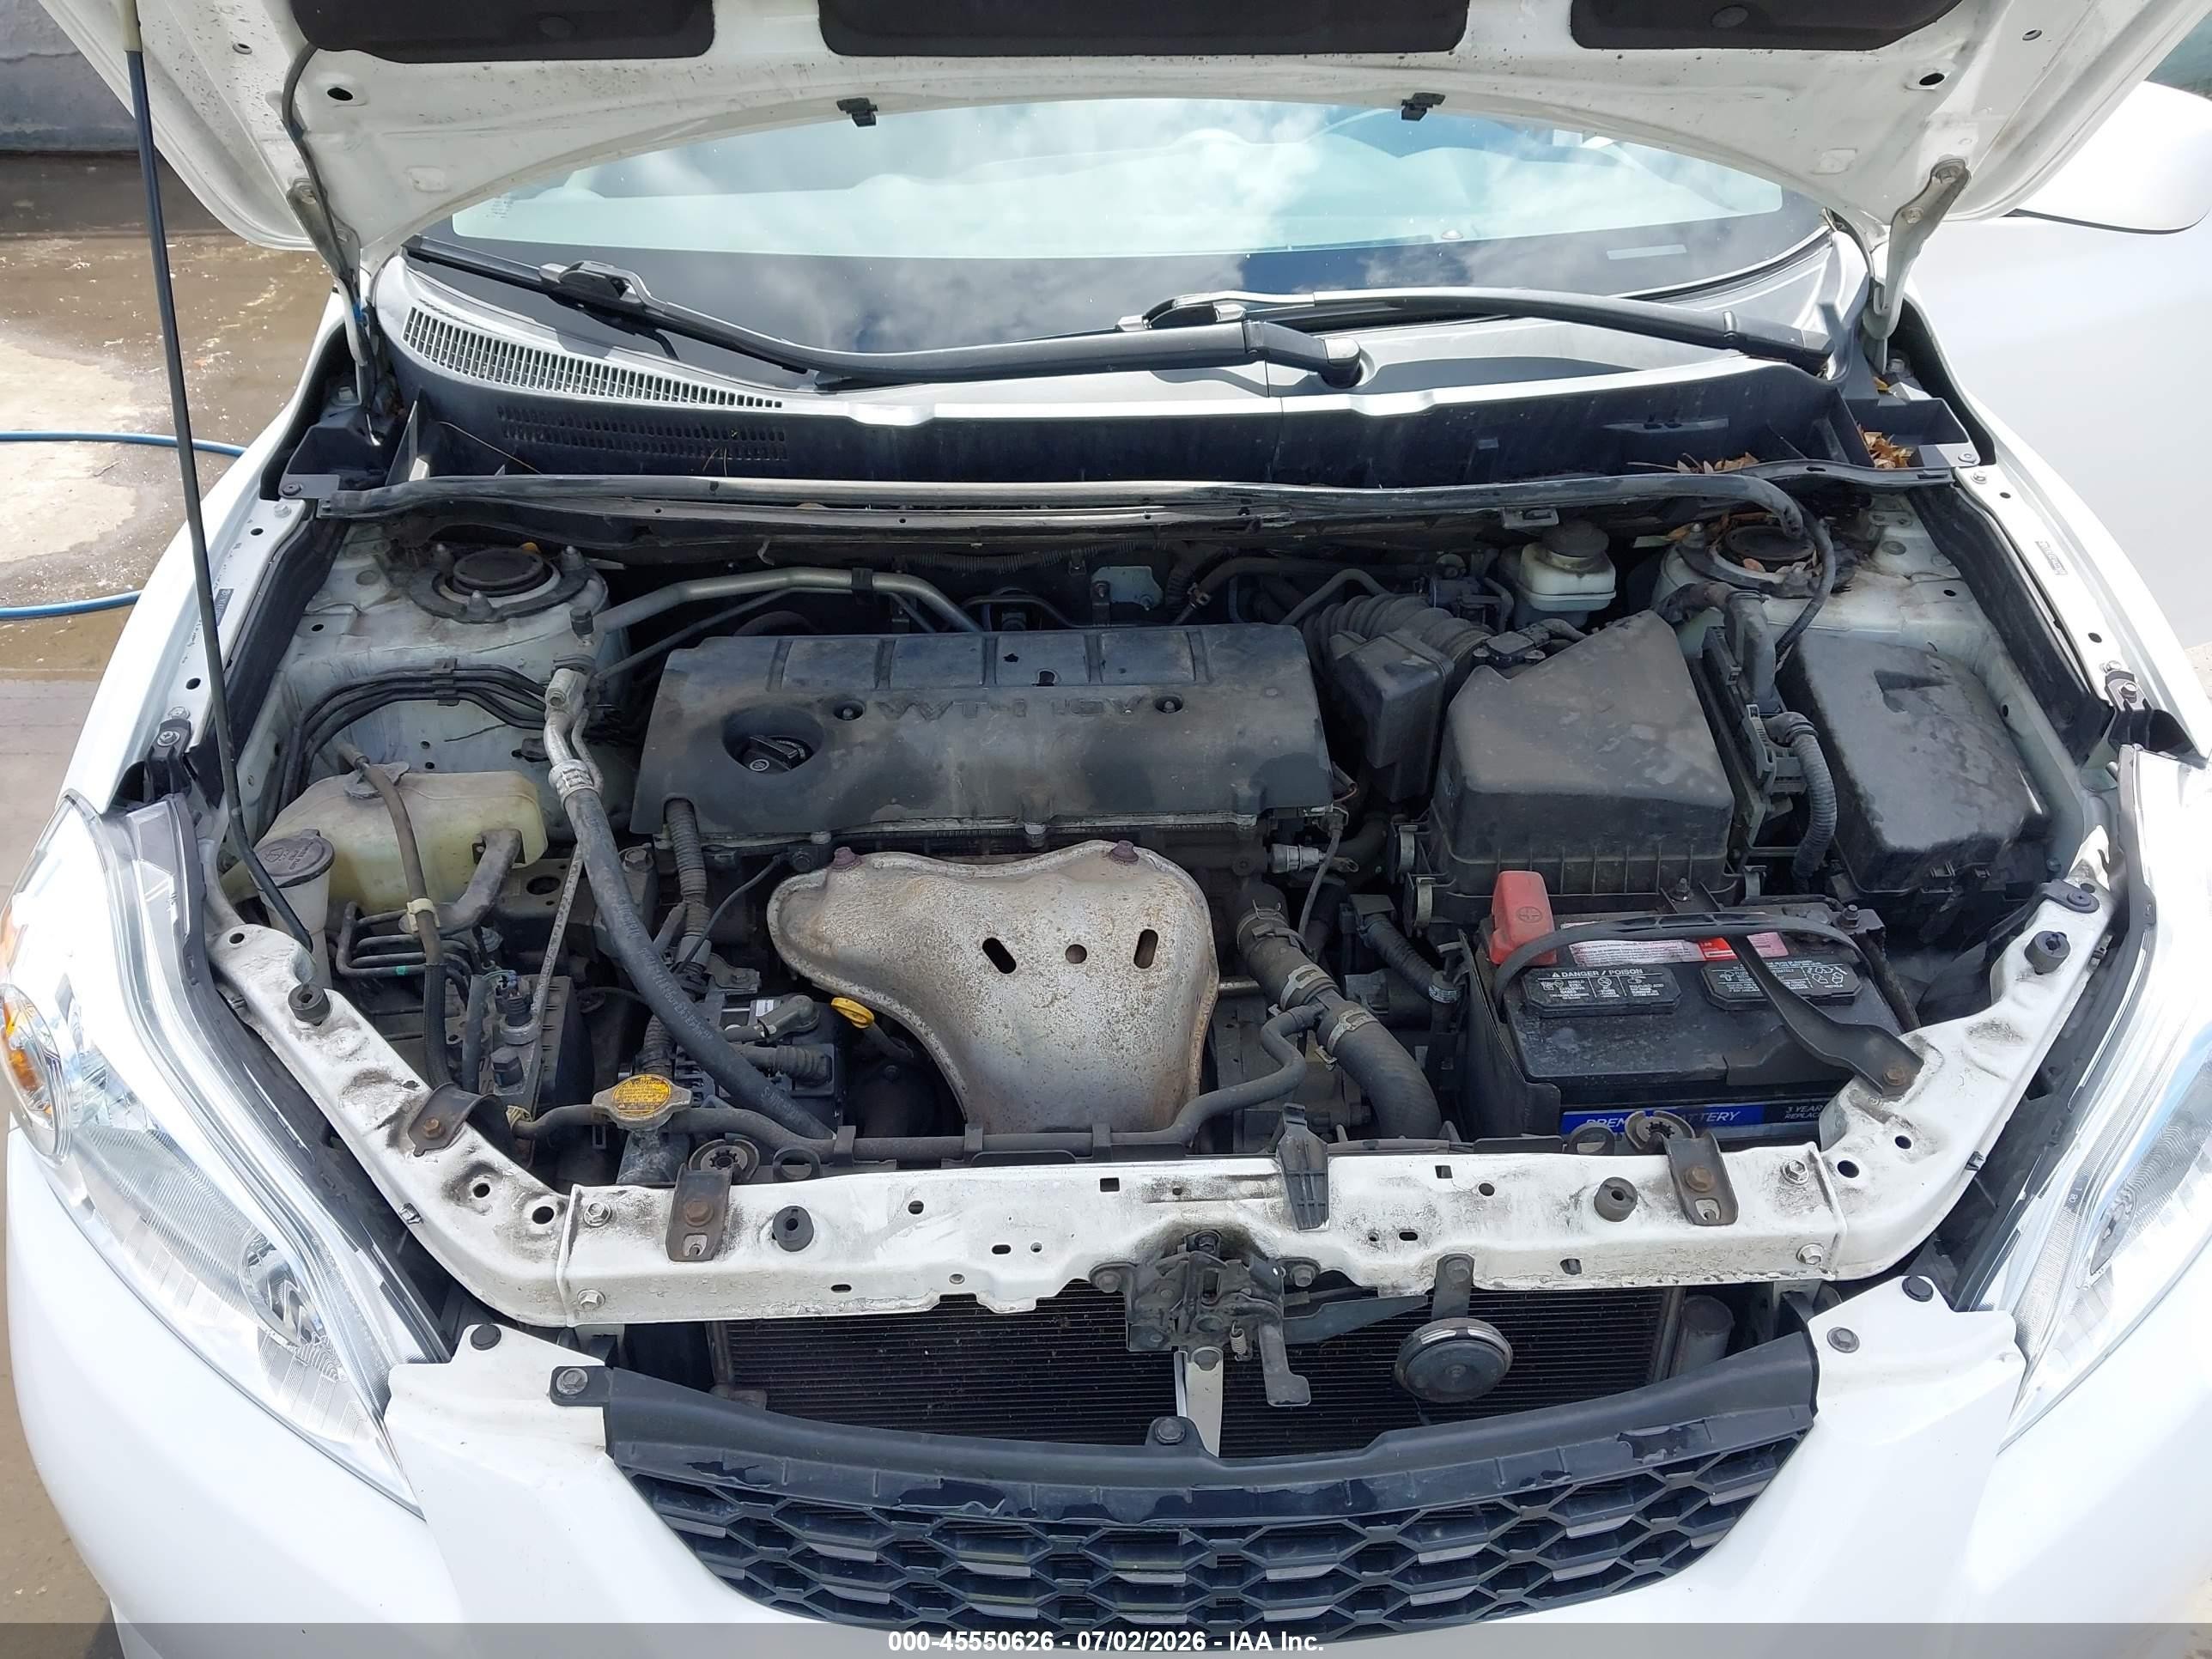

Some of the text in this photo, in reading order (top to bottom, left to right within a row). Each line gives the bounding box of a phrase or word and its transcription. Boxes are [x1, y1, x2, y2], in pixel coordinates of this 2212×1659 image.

[1795, 1104, 1823, 1113] YEAR
[1586, 1110, 1741, 1127] PREM ATTERY
